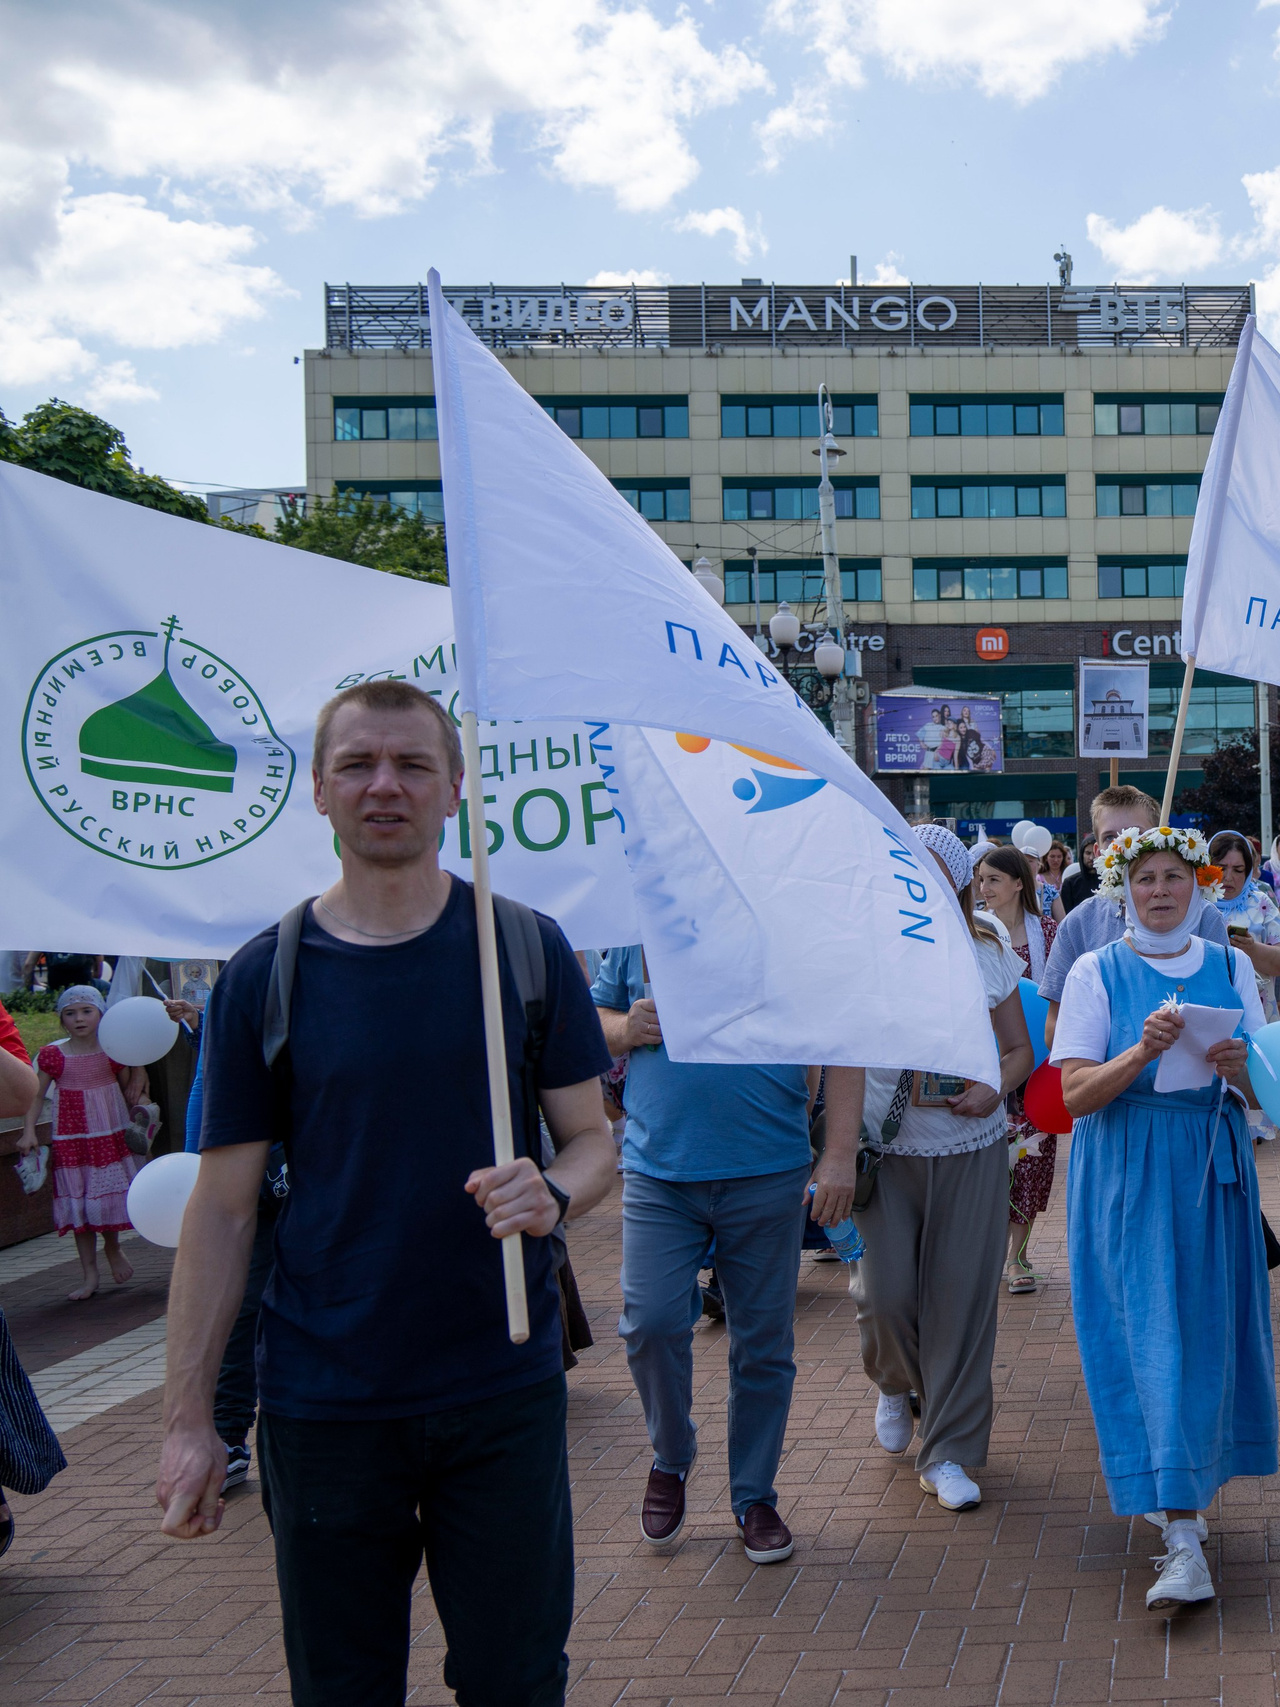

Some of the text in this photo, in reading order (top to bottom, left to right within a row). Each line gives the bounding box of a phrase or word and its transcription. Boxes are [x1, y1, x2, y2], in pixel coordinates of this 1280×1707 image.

[730, 296, 957, 332] MANGO
[1100, 295, 1186, 332] ВТБ
[34, 641, 285, 860] ВСЕМИРНЫЙ РУССКИЙ НАРОДНЫЙ СОБОР
[884, 733, 910, 742] ЛЕТО
[896, 743, 921, 752] ТВОЕ
[885, 753, 917, 763] ВРЕМЯ
[112, 790, 196, 817] ВРНС
